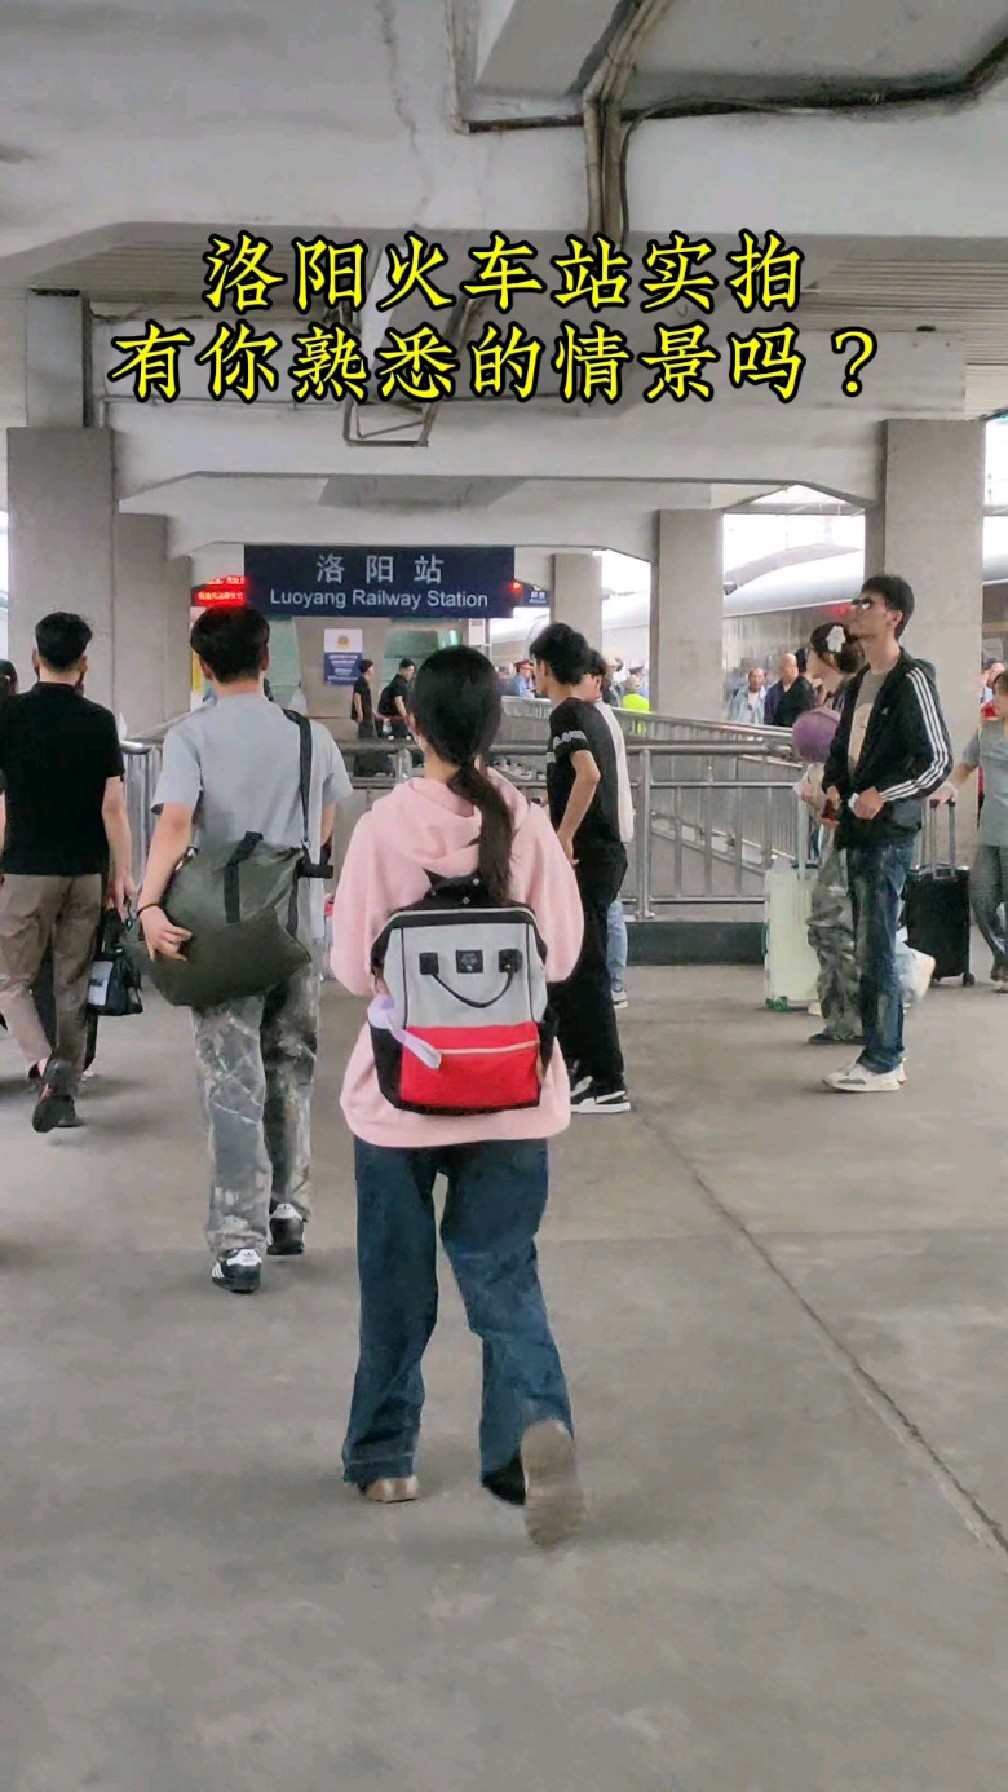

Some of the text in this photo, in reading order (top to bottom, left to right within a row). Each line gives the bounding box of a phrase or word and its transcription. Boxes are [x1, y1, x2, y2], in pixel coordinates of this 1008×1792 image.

[316, 553, 444, 584] 洛阳站
[269, 588, 346, 609] Luoyang
[352, 589, 422, 611] Railway
[427, 589, 488, 607] Station
